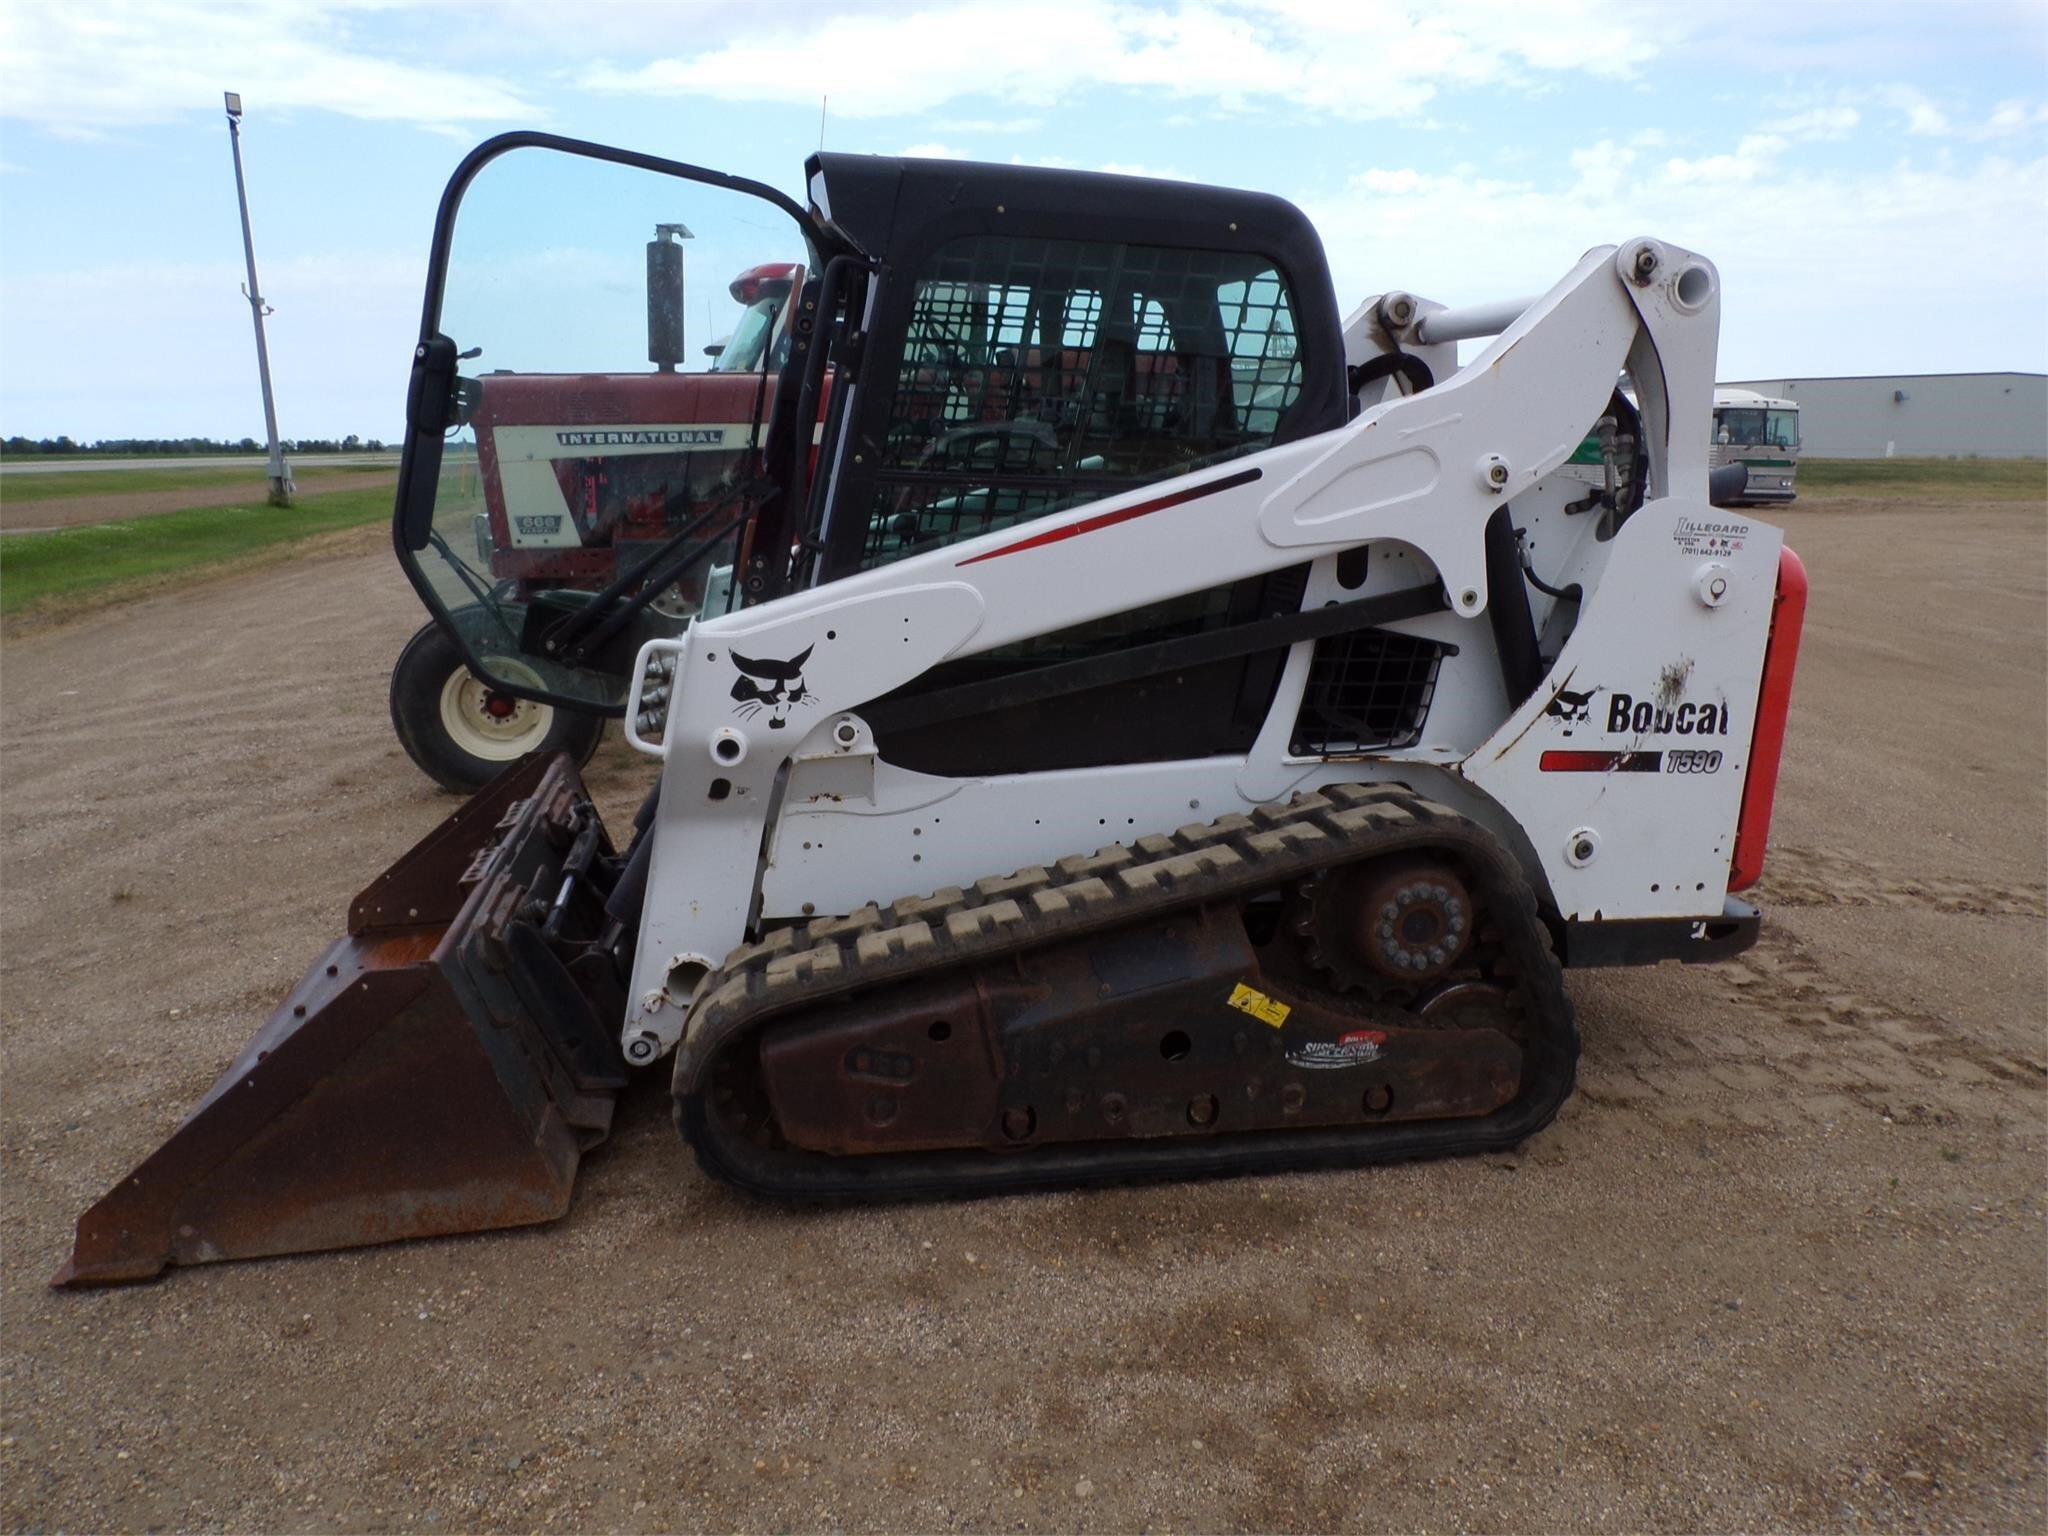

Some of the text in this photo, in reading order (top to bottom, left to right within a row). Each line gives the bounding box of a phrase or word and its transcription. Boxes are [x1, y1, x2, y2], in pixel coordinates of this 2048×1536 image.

[561, 432, 720, 444] INTERNATIONAL
[1674, 516, 1749, 536] LILLEGARD
[1682, 547, 1699, 556] (701)
[1607, 693, 1729, 736] Bobcat
[1666, 750, 1723, 774] T590
